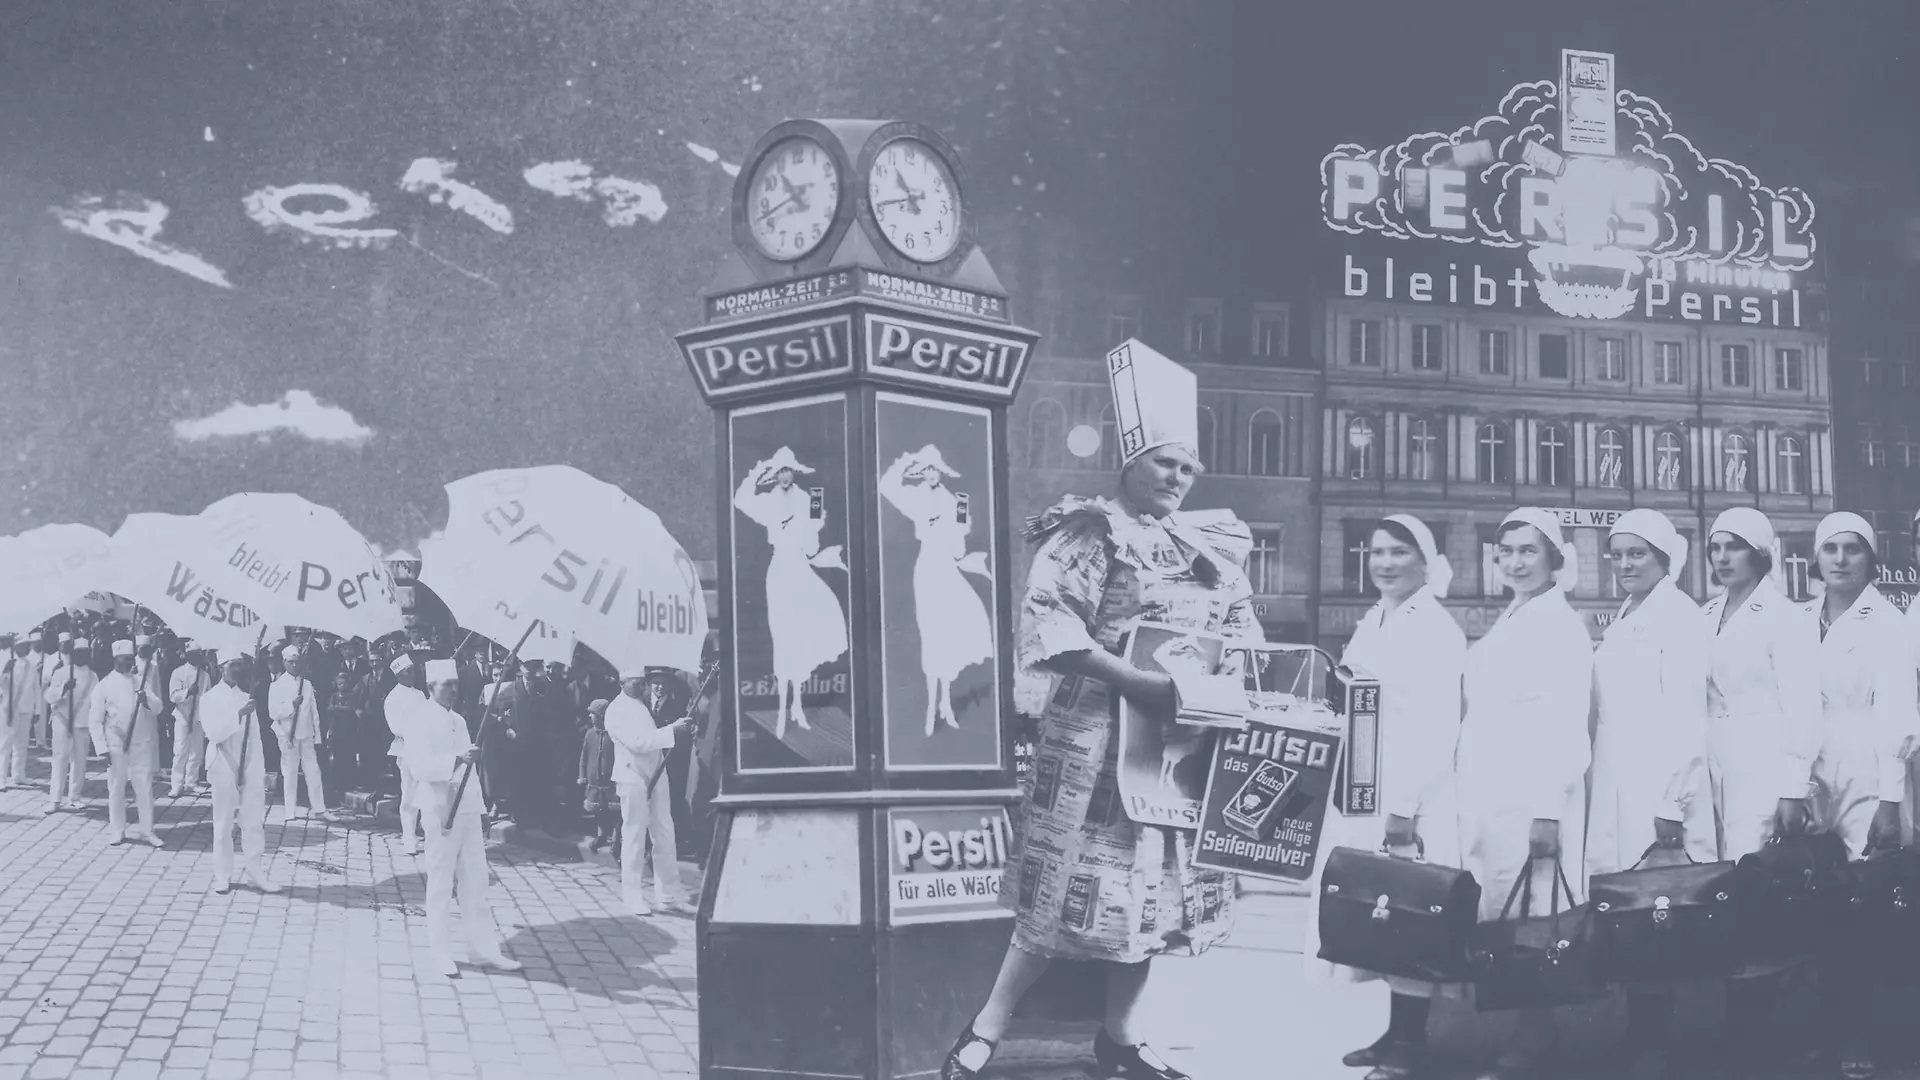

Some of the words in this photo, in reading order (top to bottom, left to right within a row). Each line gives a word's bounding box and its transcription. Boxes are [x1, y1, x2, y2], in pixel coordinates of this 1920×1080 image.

[939, 200, 949, 217] 3
[1332, 158, 1809, 259] PERSIL
[888, 223, 898, 240] 7
[933, 219, 943, 235] 4
[779, 229, 788, 248] 7
[793, 231, 805, 250] 6
[904, 232, 916, 250] 6
[1344, 254, 1530, 308] bleibt
[1645, 277, 1801, 328] Persil
[705, 325, 837, 381] Persil
[878, 324, 1010, 378] Persil
[1589, 511, 1622, 526] WE
[227, 541, 292, 594] bleibt
[1365, 688, 1377, 711] Persil
[1223, 757, 1249, 773] das
[1283, 817, 1313, 832] neue
[893, 815, 1008, 868] Persil
[1273, 826, 1312, 847] billige
[1202, 829, 1312, 867] Seifenpulver
[898, 879, 920, 901] für
[926, 878, 957, 898] alle
